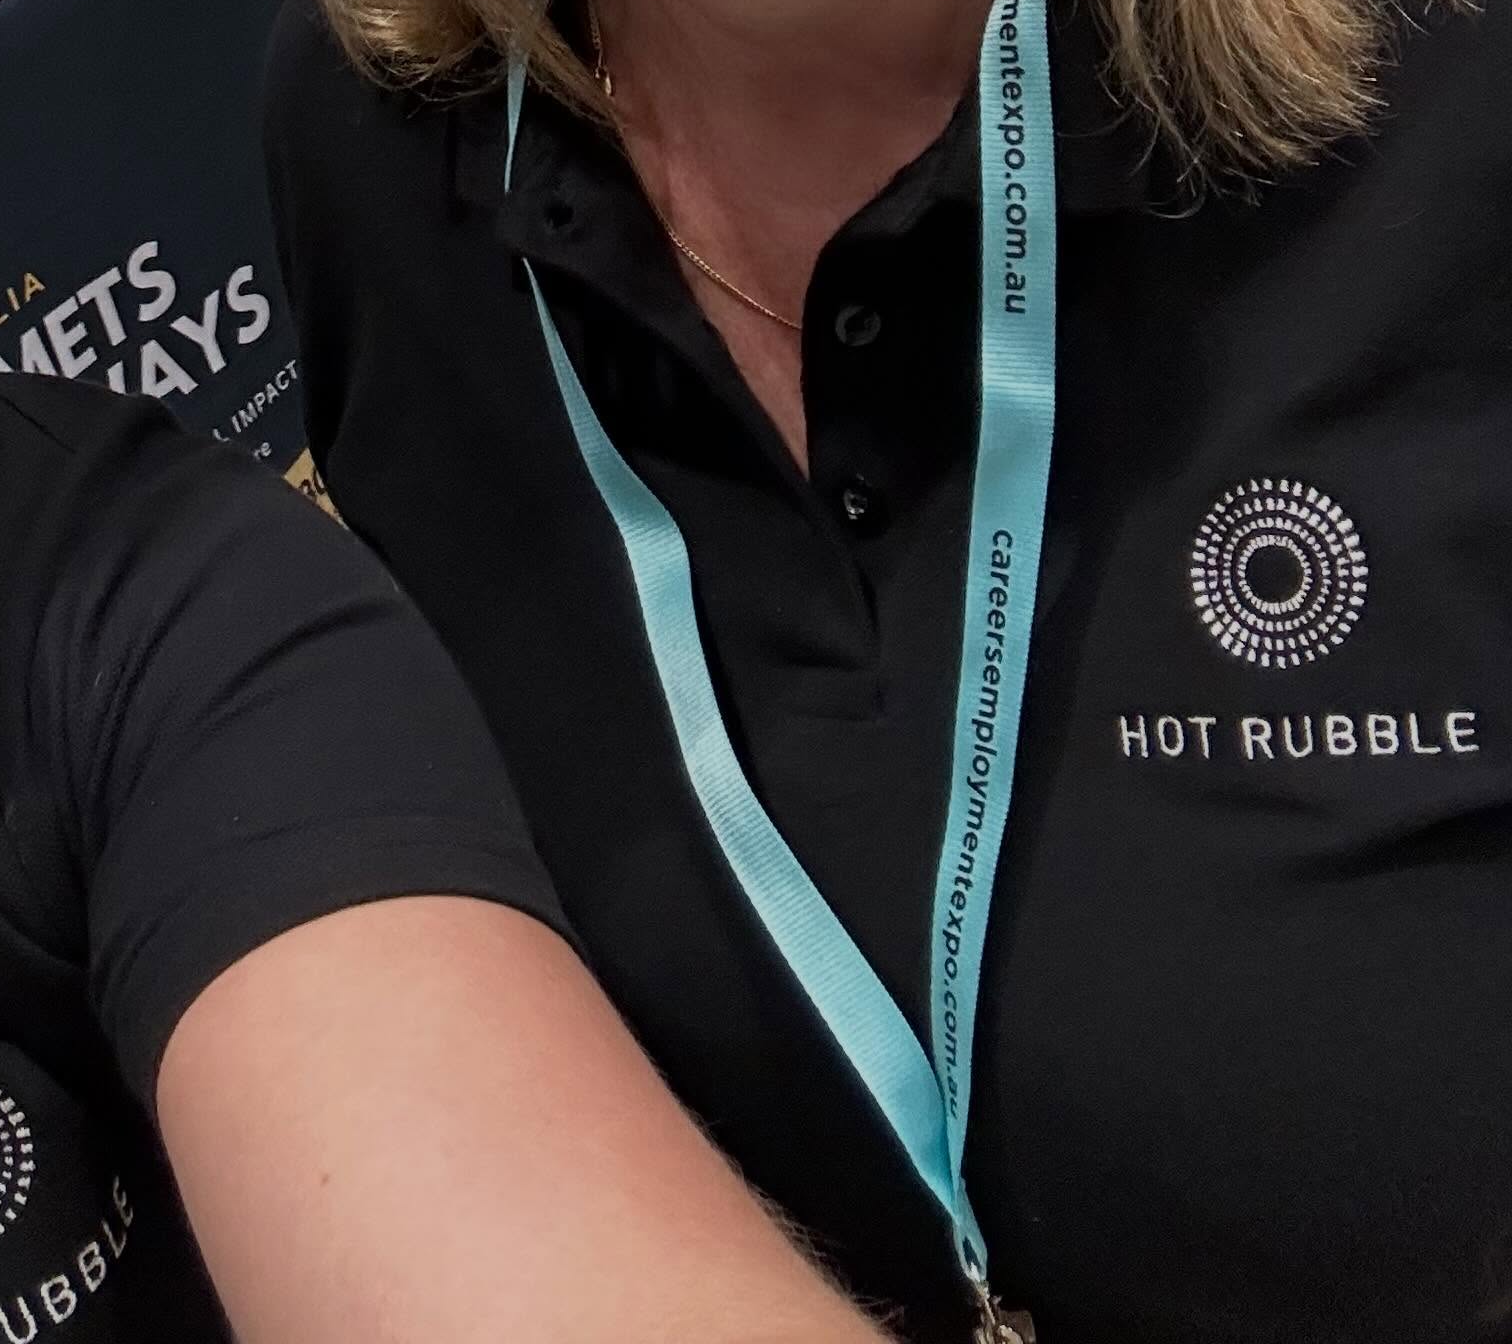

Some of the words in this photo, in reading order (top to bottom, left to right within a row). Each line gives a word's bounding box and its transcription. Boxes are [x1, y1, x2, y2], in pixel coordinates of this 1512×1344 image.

[231, 359, 298, 434] IMPACT
[1119, 714, 1218, 760] HOT
[1241, 712, 1480, 760] RUBBLE
[941, 526, 1013, 1122] careersemploymentexpo.com.au
